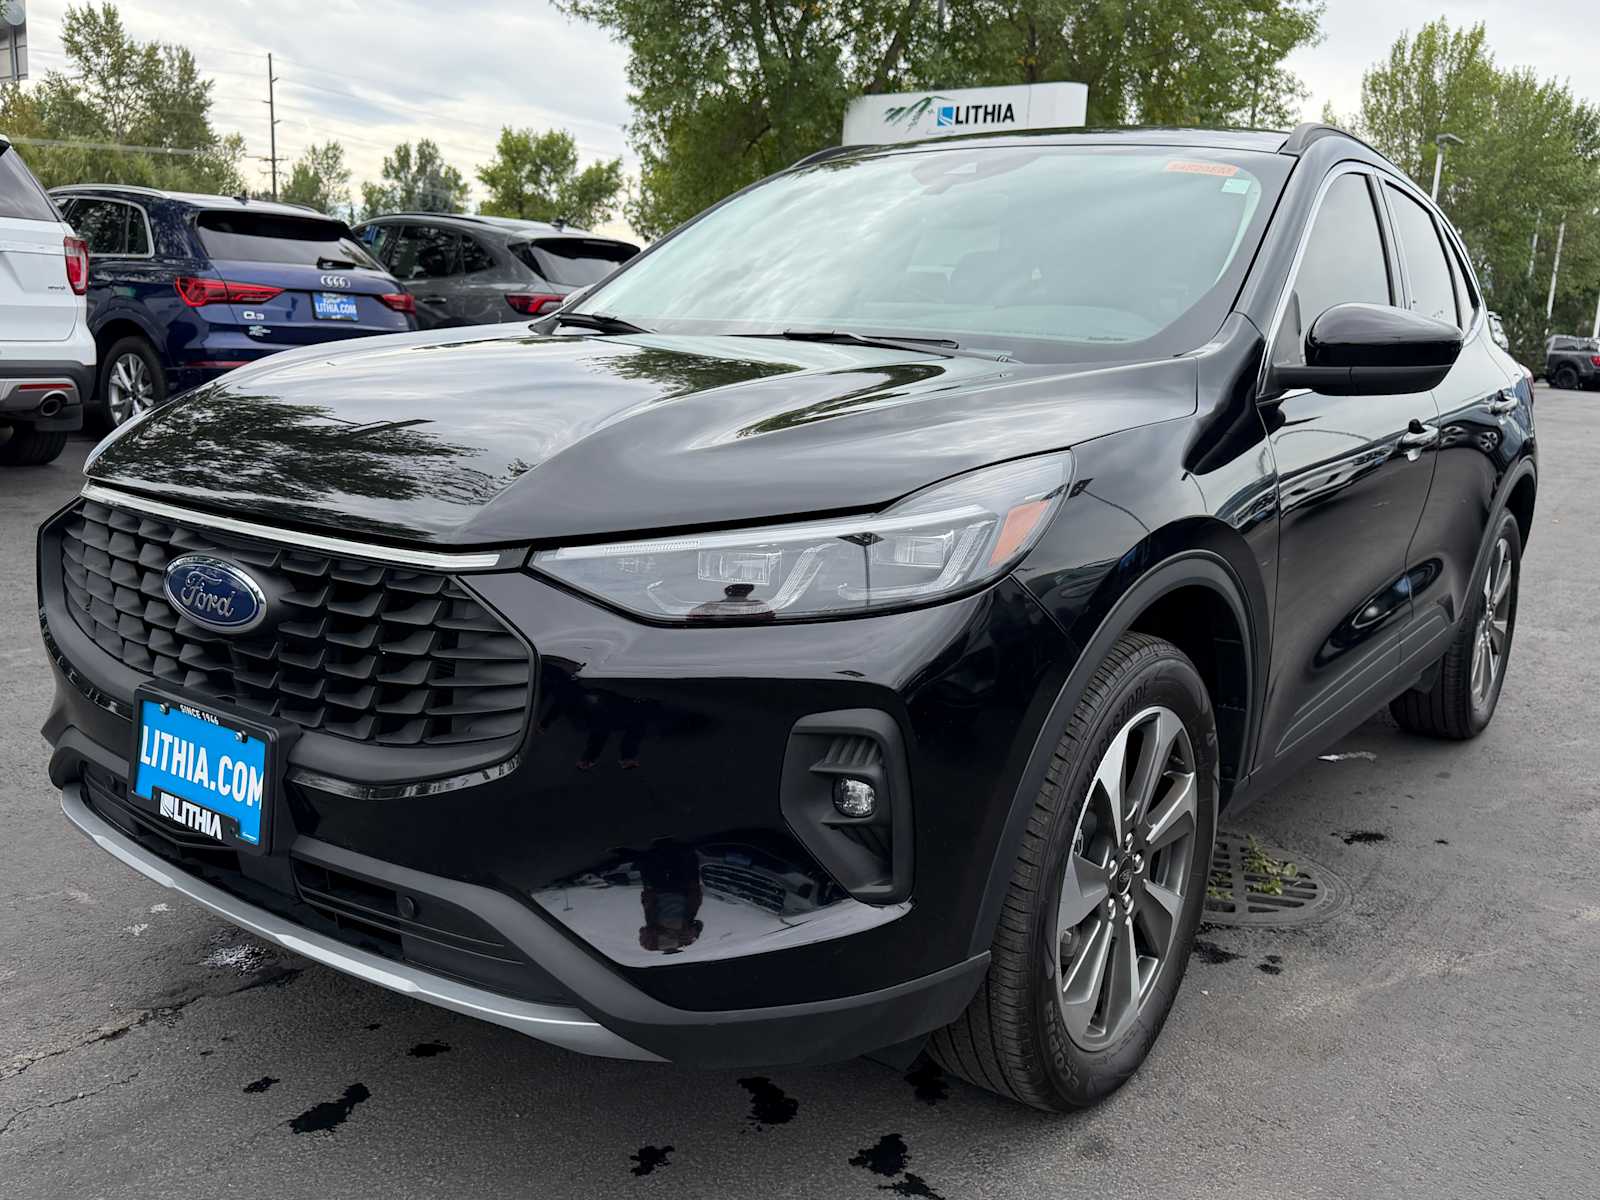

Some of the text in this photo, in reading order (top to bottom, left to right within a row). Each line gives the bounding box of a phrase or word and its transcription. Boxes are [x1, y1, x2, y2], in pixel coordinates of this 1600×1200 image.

[955, 104, 1015, 125] LITHIA
[315, 301, 357, 314] LITHIA.COM
[181, 571, 236, 617] Ford
[179, 704, 220, 726] SINCE 1946
[140, 725, 265, 810] LITHIA.COM
[173, 797, 223, 840] LITHIA
